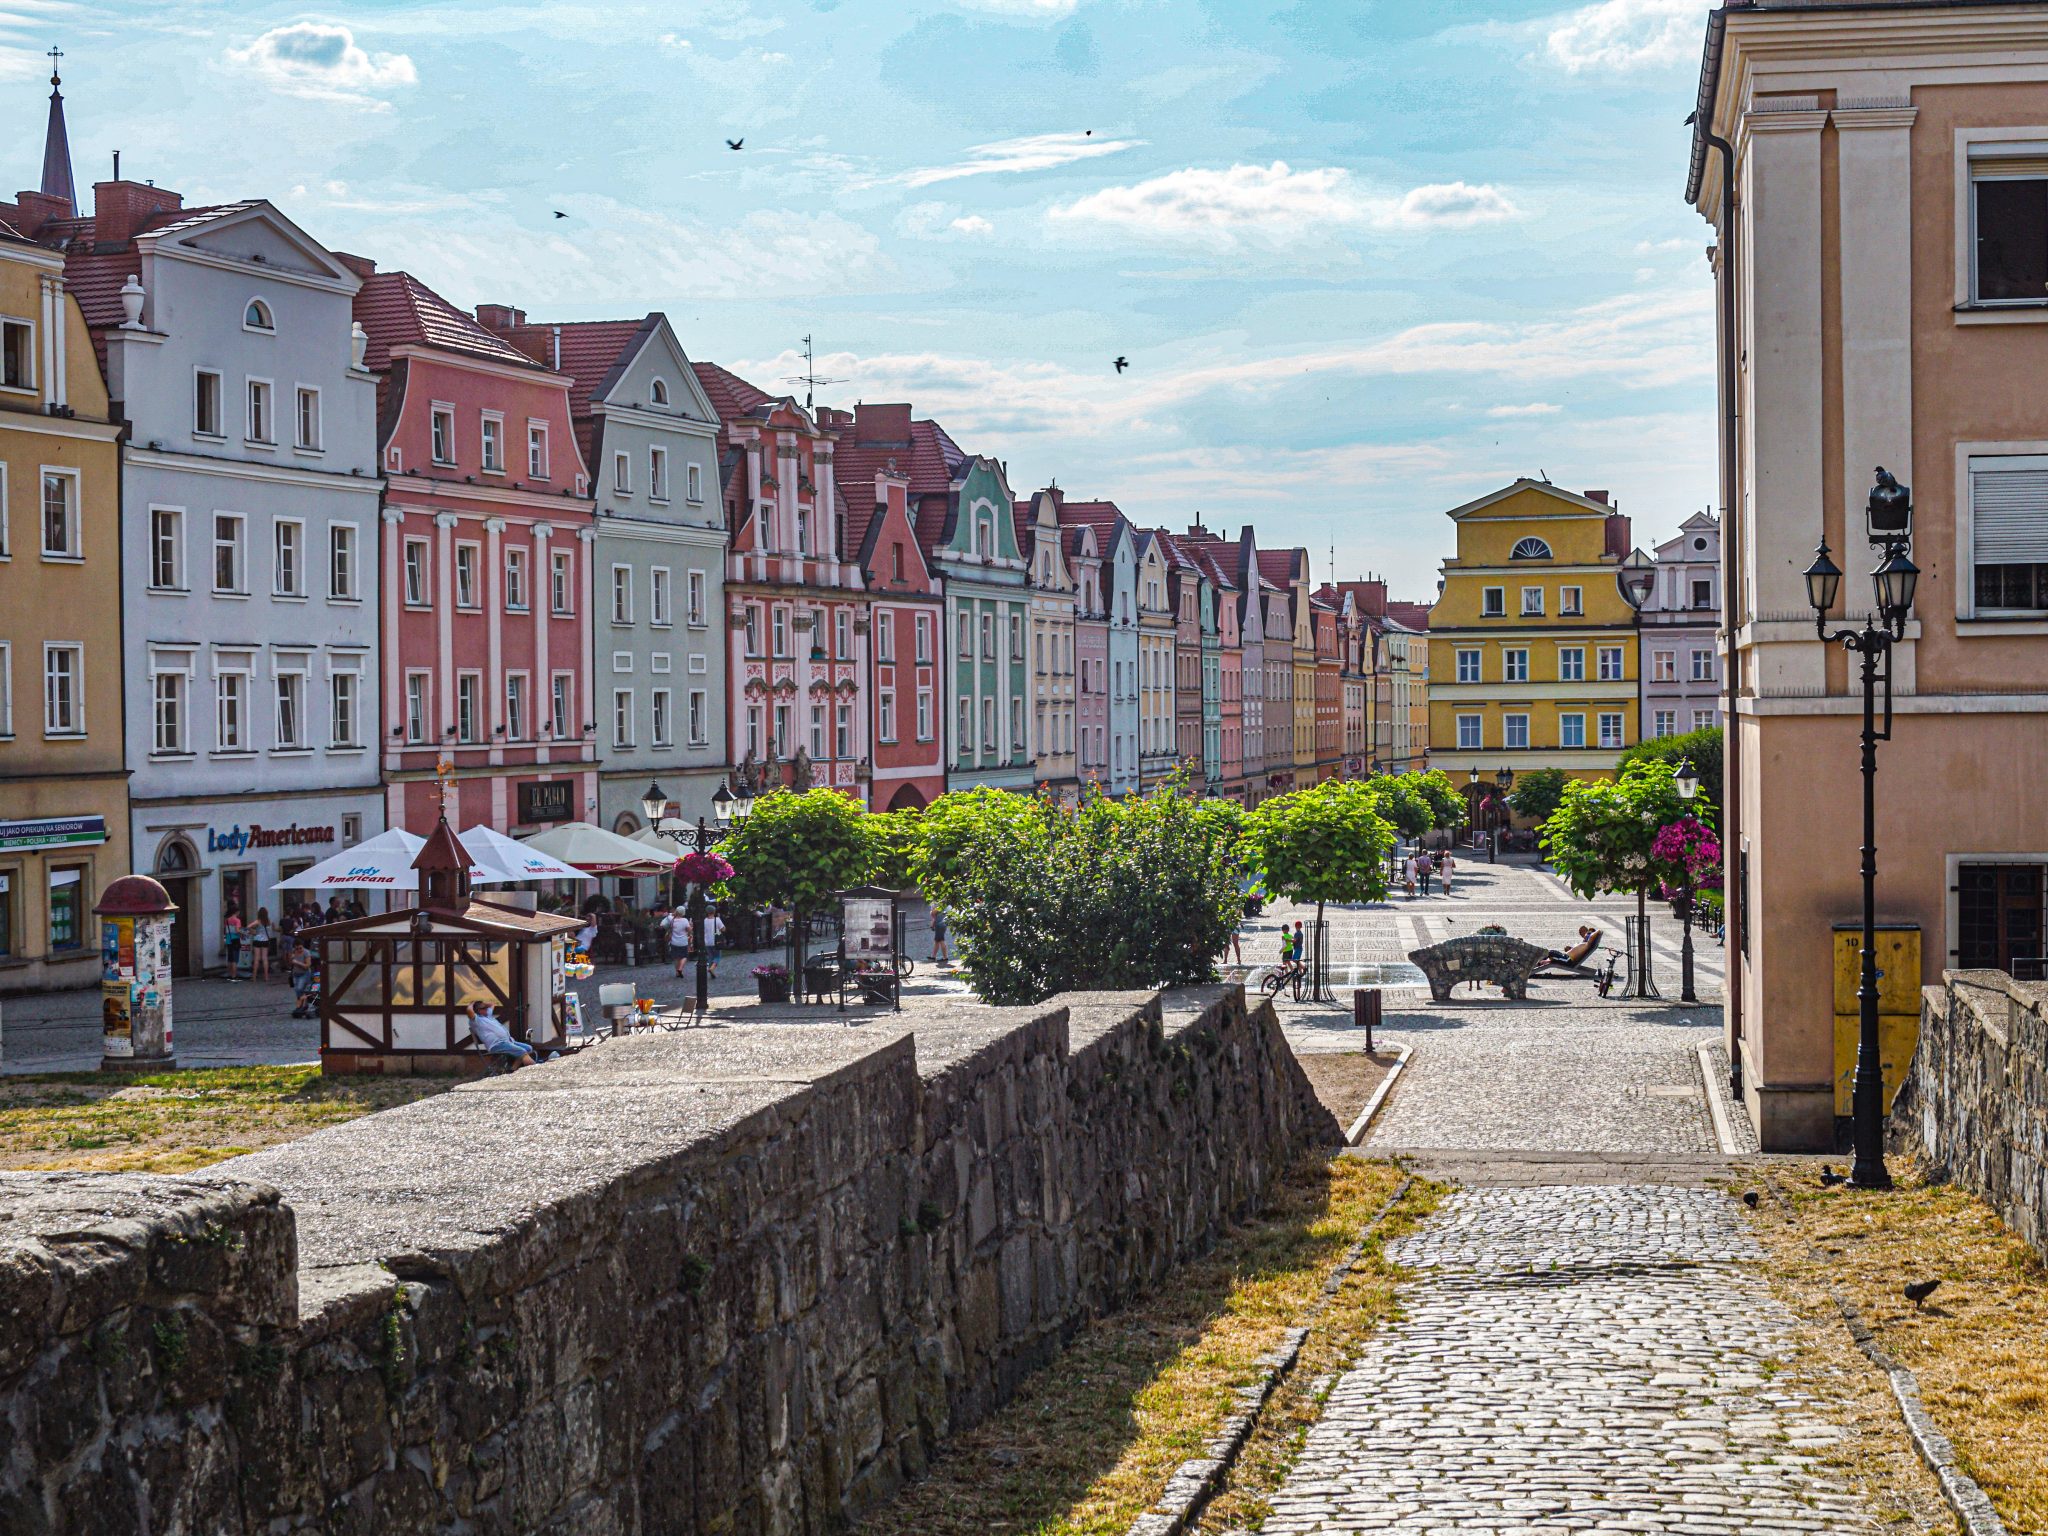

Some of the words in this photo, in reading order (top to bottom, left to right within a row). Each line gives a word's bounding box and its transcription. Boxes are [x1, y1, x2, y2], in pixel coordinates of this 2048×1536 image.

[6, 827, 20, 837] JAKO
[54, 821, 84, 832] SENIORÓW
[208, 824, 249, 856] Lody
[247, 822, 335, 848] Americana
[347, 866, 380, 876] Lody
[321, 874, 396, 884] Americana
